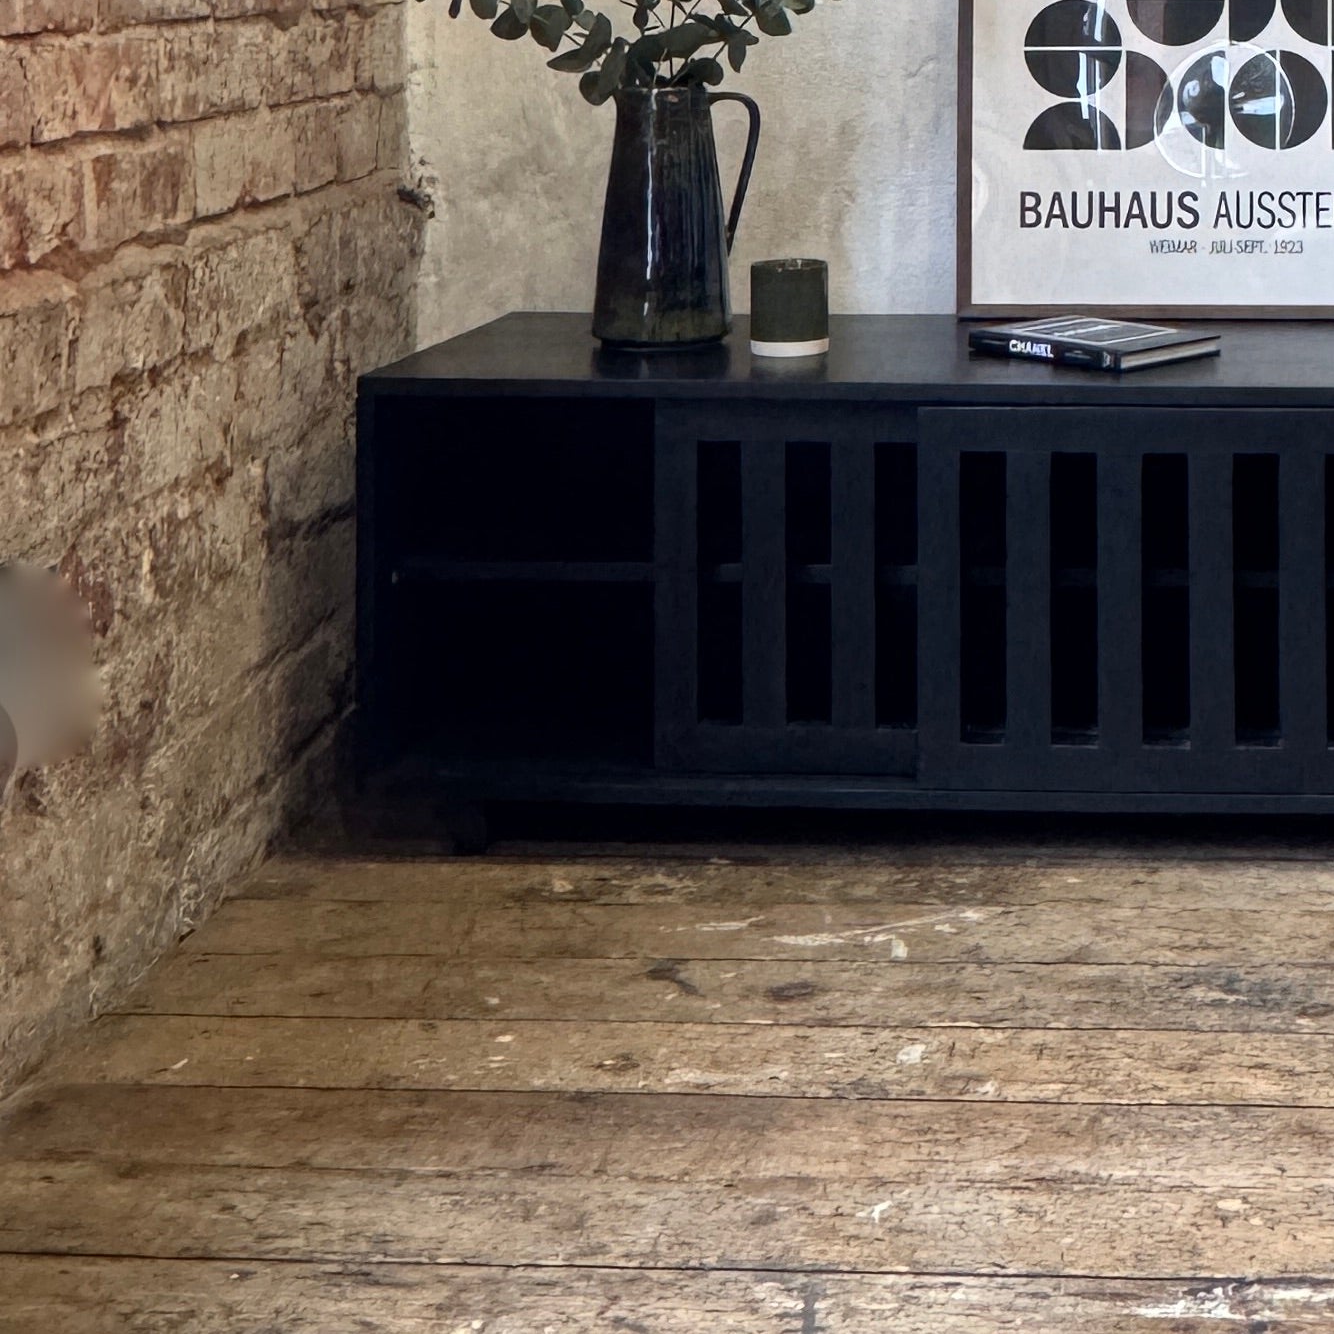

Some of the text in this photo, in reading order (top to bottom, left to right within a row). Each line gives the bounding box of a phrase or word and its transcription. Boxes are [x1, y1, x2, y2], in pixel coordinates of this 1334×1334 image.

[1019, 190, 1200, 230] BAUHAUS
[1273, 240, 1304, 254] 1923
[1009, 339, 1054, 358] CHANEL
